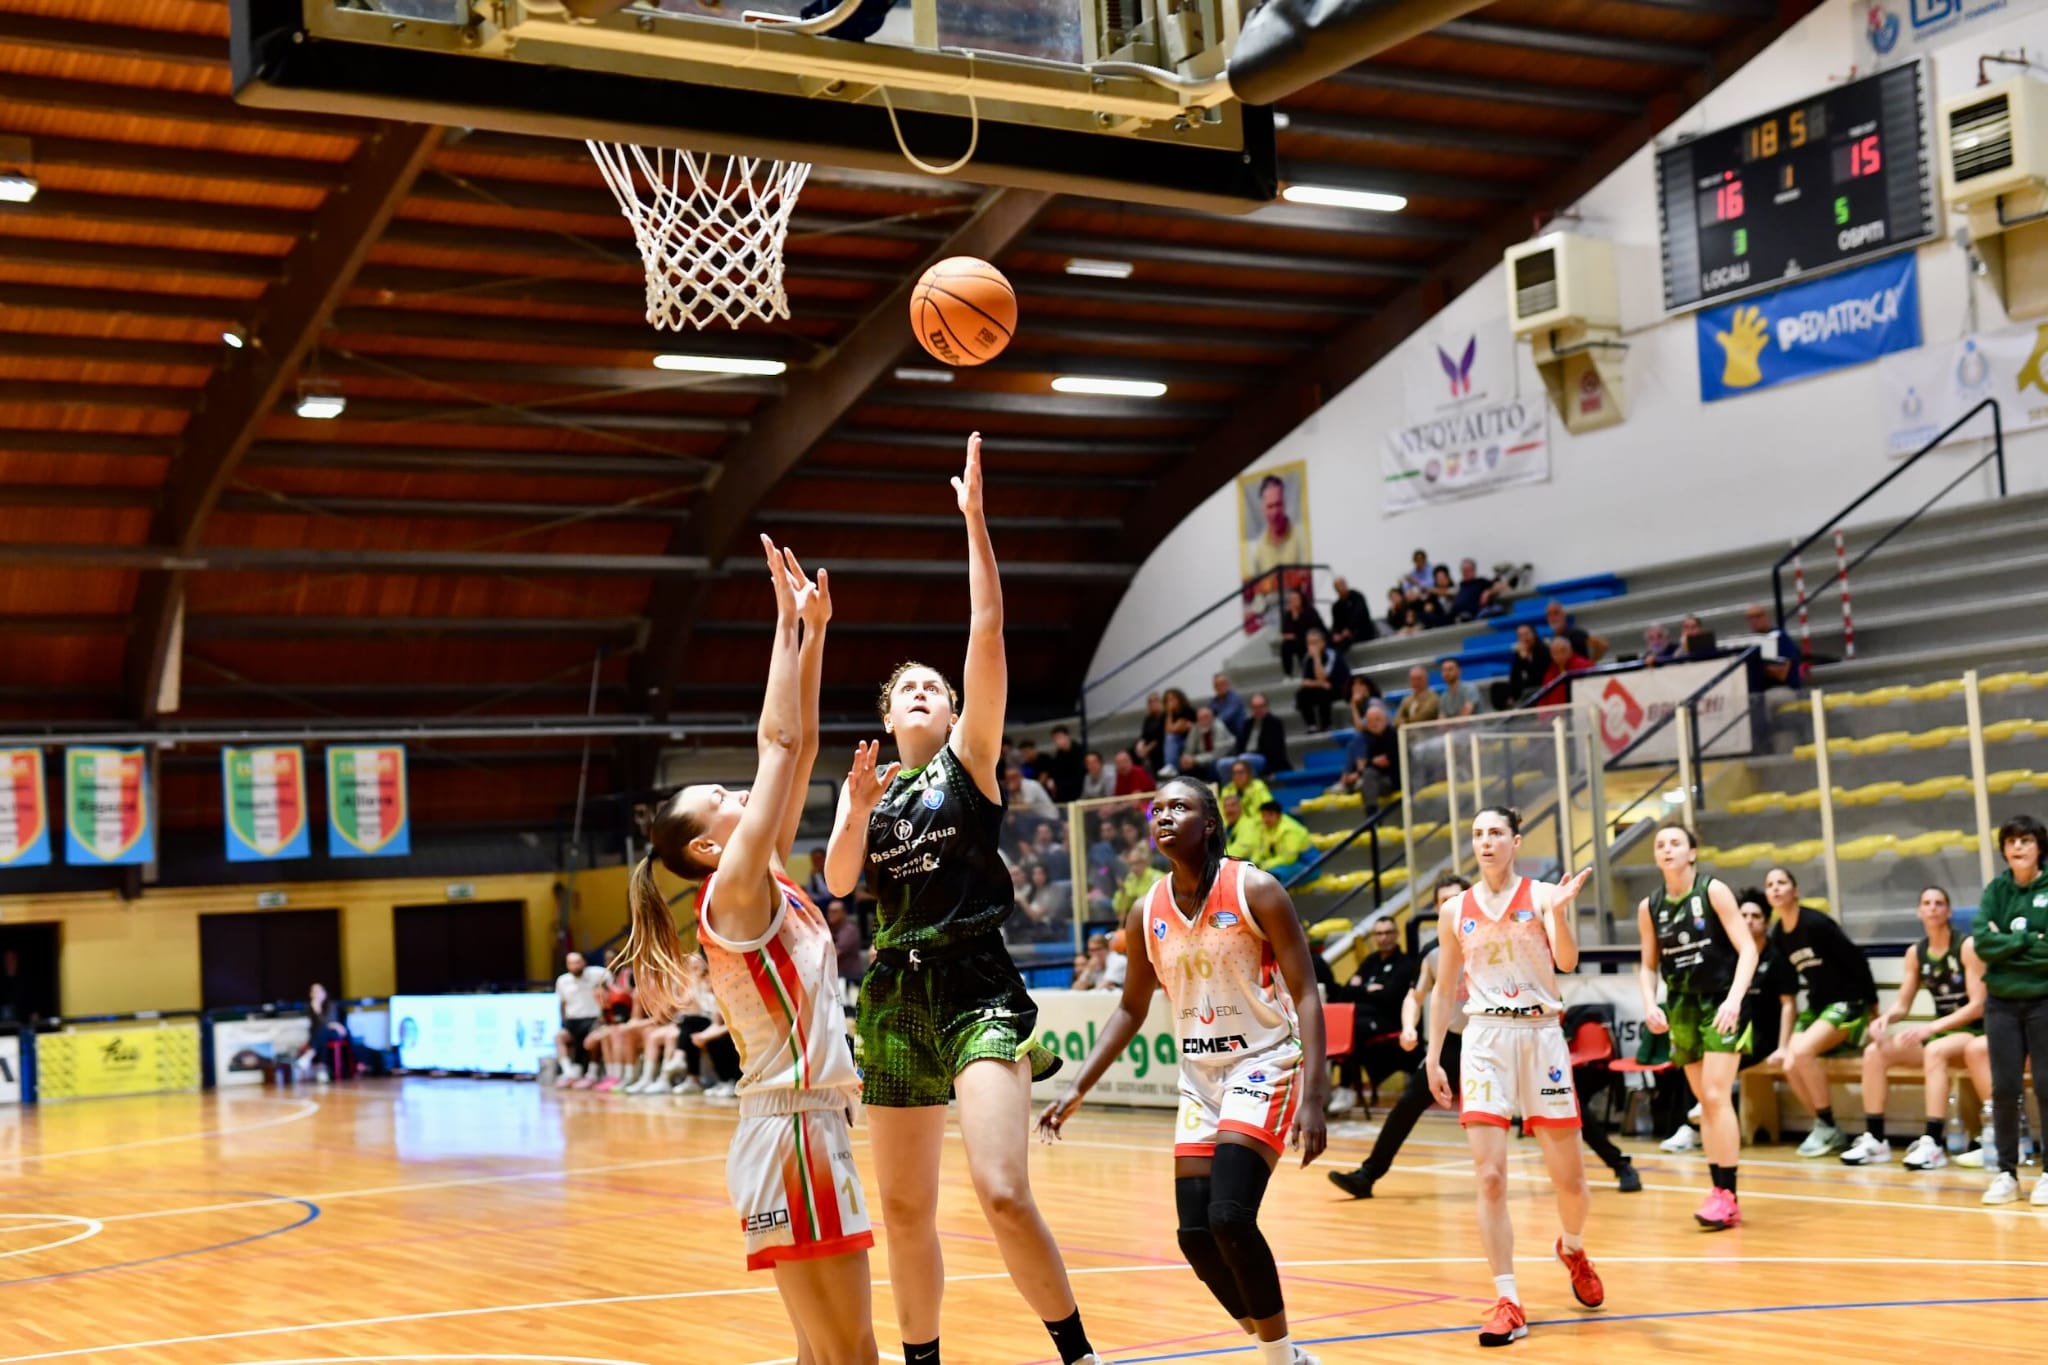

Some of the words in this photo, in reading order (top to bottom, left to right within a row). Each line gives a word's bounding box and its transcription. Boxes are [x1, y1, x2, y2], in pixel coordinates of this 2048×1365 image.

[1851, 135, 1881, 177] 15
[1717, 181, 1745, 220] 16
[1834, 196, 1849, 224] 5
[1702, 261, 1750, 291] LOCALI
[1776, 288, 1900, 352] PEDIATRICA
[870, 826, 957, 863] Passalacqua
[1176, 949, 1213, 980] 16
[1484, 938, 1514, 965] 21
[1216, 1005, 1242, 1017] EDIL
[1465, 1079, 1492, 1102] 21
